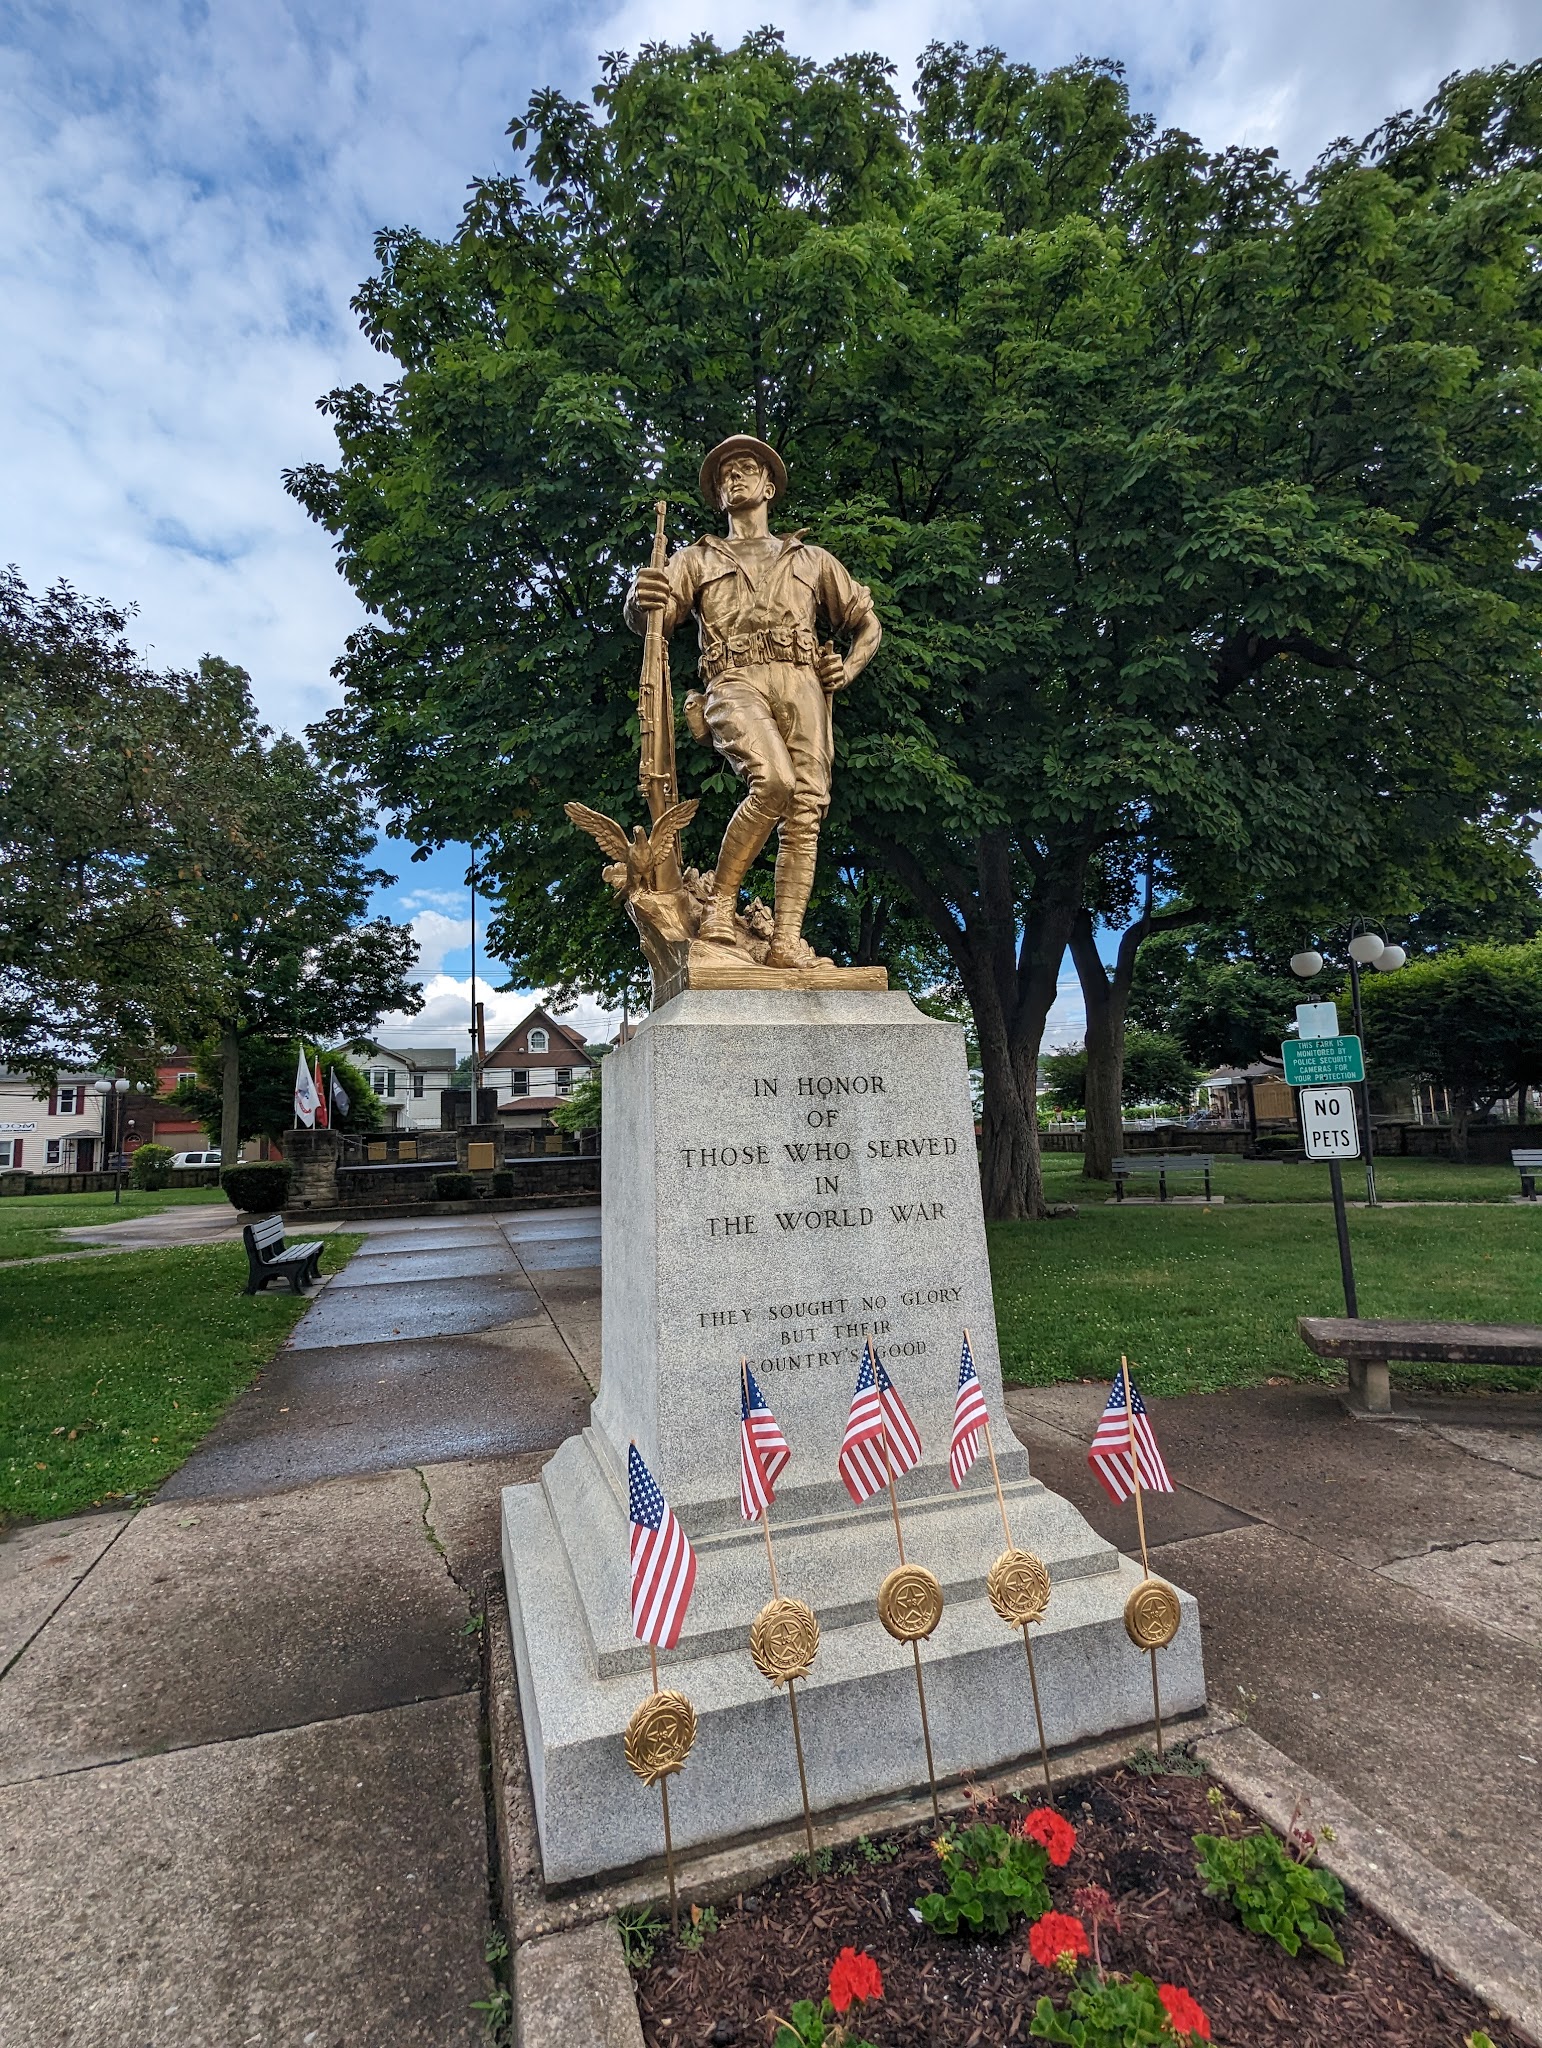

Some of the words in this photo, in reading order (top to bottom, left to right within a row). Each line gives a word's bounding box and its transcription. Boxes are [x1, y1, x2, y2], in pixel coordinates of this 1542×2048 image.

[1293, 1058, 1316, 1066] POLICE
[1320, 1056, 1352, 1064] SECURITY
[1297, 1049, 1335, 1057] MONITORED
[1300, 1066, 1332, 1074] CAMERAS
[1315, 1072, 1357, 1081] PROTECTION
[754, 1078, 778, 1097] IN
[798, 1075, 886, 1096] HONOR
[1315, 1098, 1340, 1116] NO
[807, 1110, 839, 1128] OF
[1312, 1130, 1350, 1148] PETS
[680, 1145, 770, 1168] THOSE
[784, 1142, 851, 1163] WHO
[867, 1137, 958, 1159] SERVED
[815, 1175, 839, 1195] IN
[706, 1216, 759, 1237] THE
[775, 1208, 874, 1231] WORLD
[890, 1203, 946, 1224] WAR
[697, 1308, 753, 1328] THEY
[769, 1299, 849, 1321] SOUGHT
[862, 1295, 887, 1311] NO
[901, 1287, 963, 1307] GLORY
[780, 1328, 819, 1346] BUT
[833, 1320, 891, 1340] THEIR
